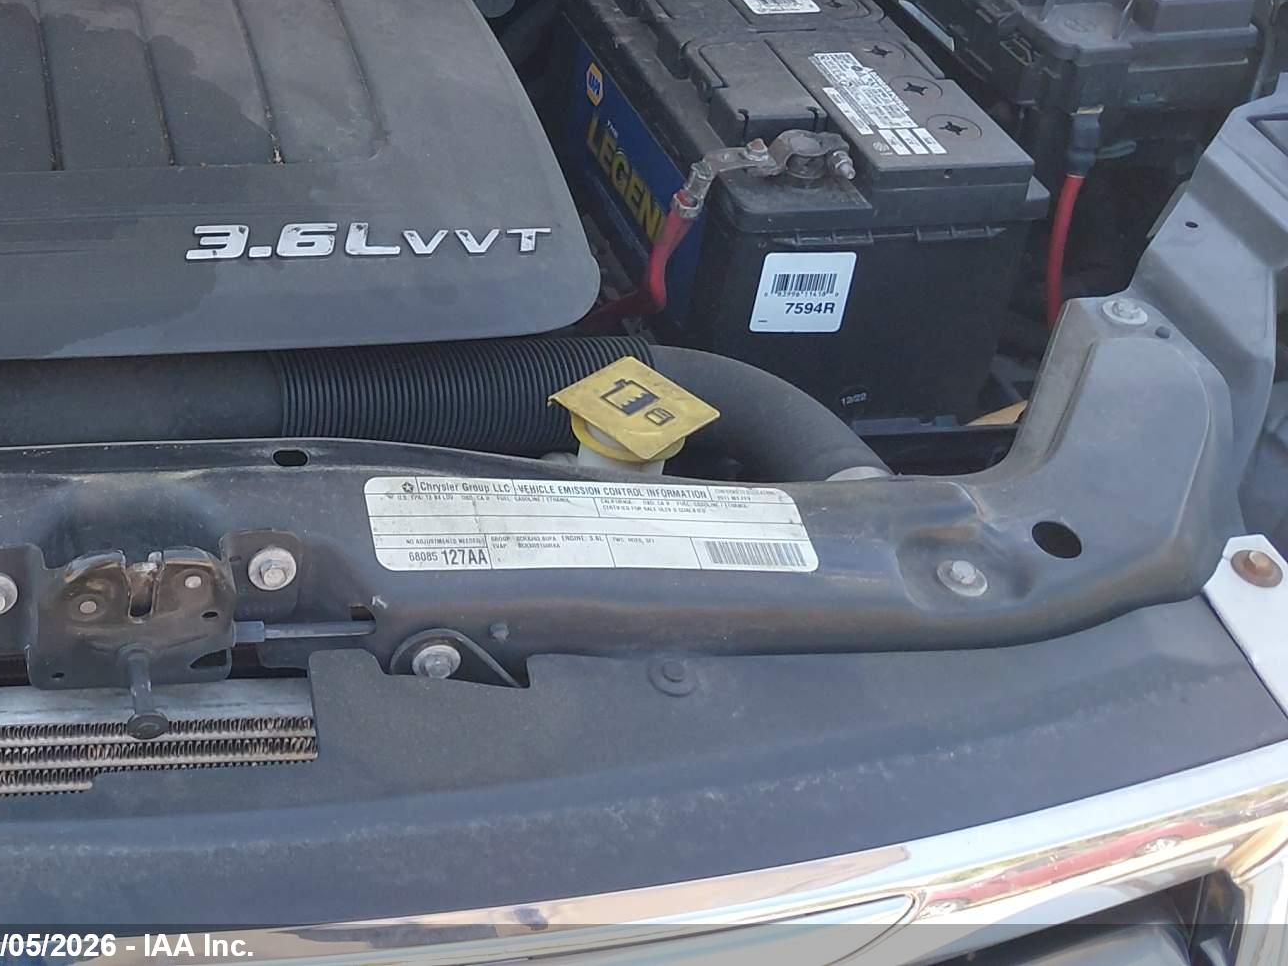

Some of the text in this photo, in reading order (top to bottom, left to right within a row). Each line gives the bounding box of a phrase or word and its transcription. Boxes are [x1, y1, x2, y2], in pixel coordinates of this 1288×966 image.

[586, 110, 667, 244] LEGEN
[185, 222, 552, 260] 3.6L VVT
[784, 302, 836, 315] 7594R
[419, 482, 511, 495] Chrysler Group LLC
[517, 484, 556, 495] VEHICLE
[558, 486, 601, 496] EMISSION
[603, 487, 644, 497] CONTROL
[646, 489, 707, 499] INFORMATION
[409, 549, 488, 566] 68085 127AA
